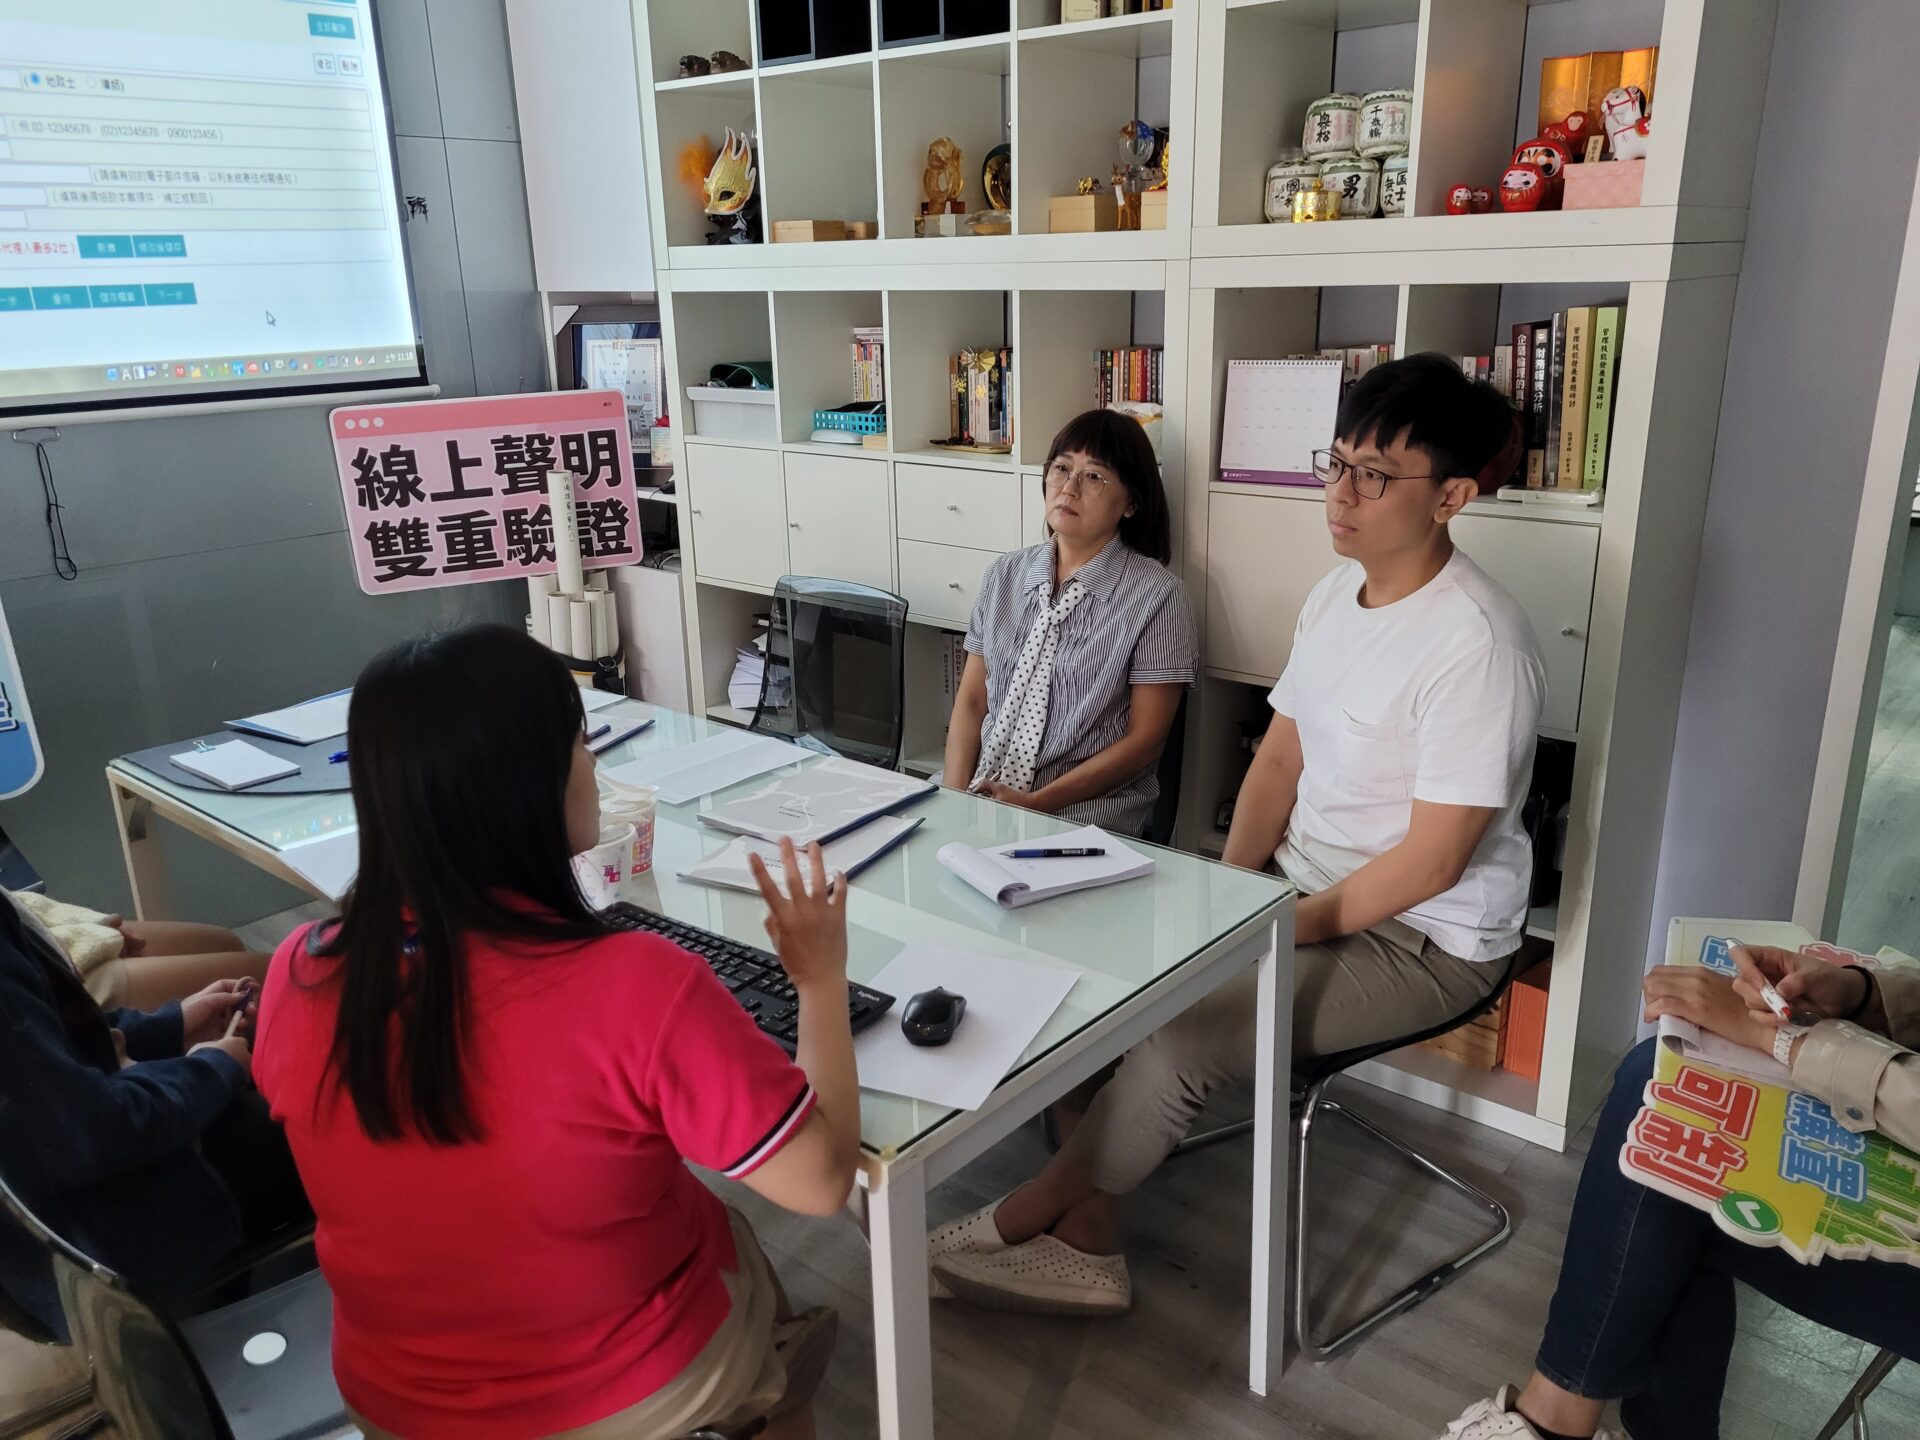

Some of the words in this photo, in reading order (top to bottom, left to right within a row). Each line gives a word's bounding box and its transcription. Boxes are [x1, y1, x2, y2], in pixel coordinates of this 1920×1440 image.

[351, 429, 622, 511] 線上聲明
[364, 497, 633, 583] 雙重驗證
[857, 990, 881, 1002] logitech
